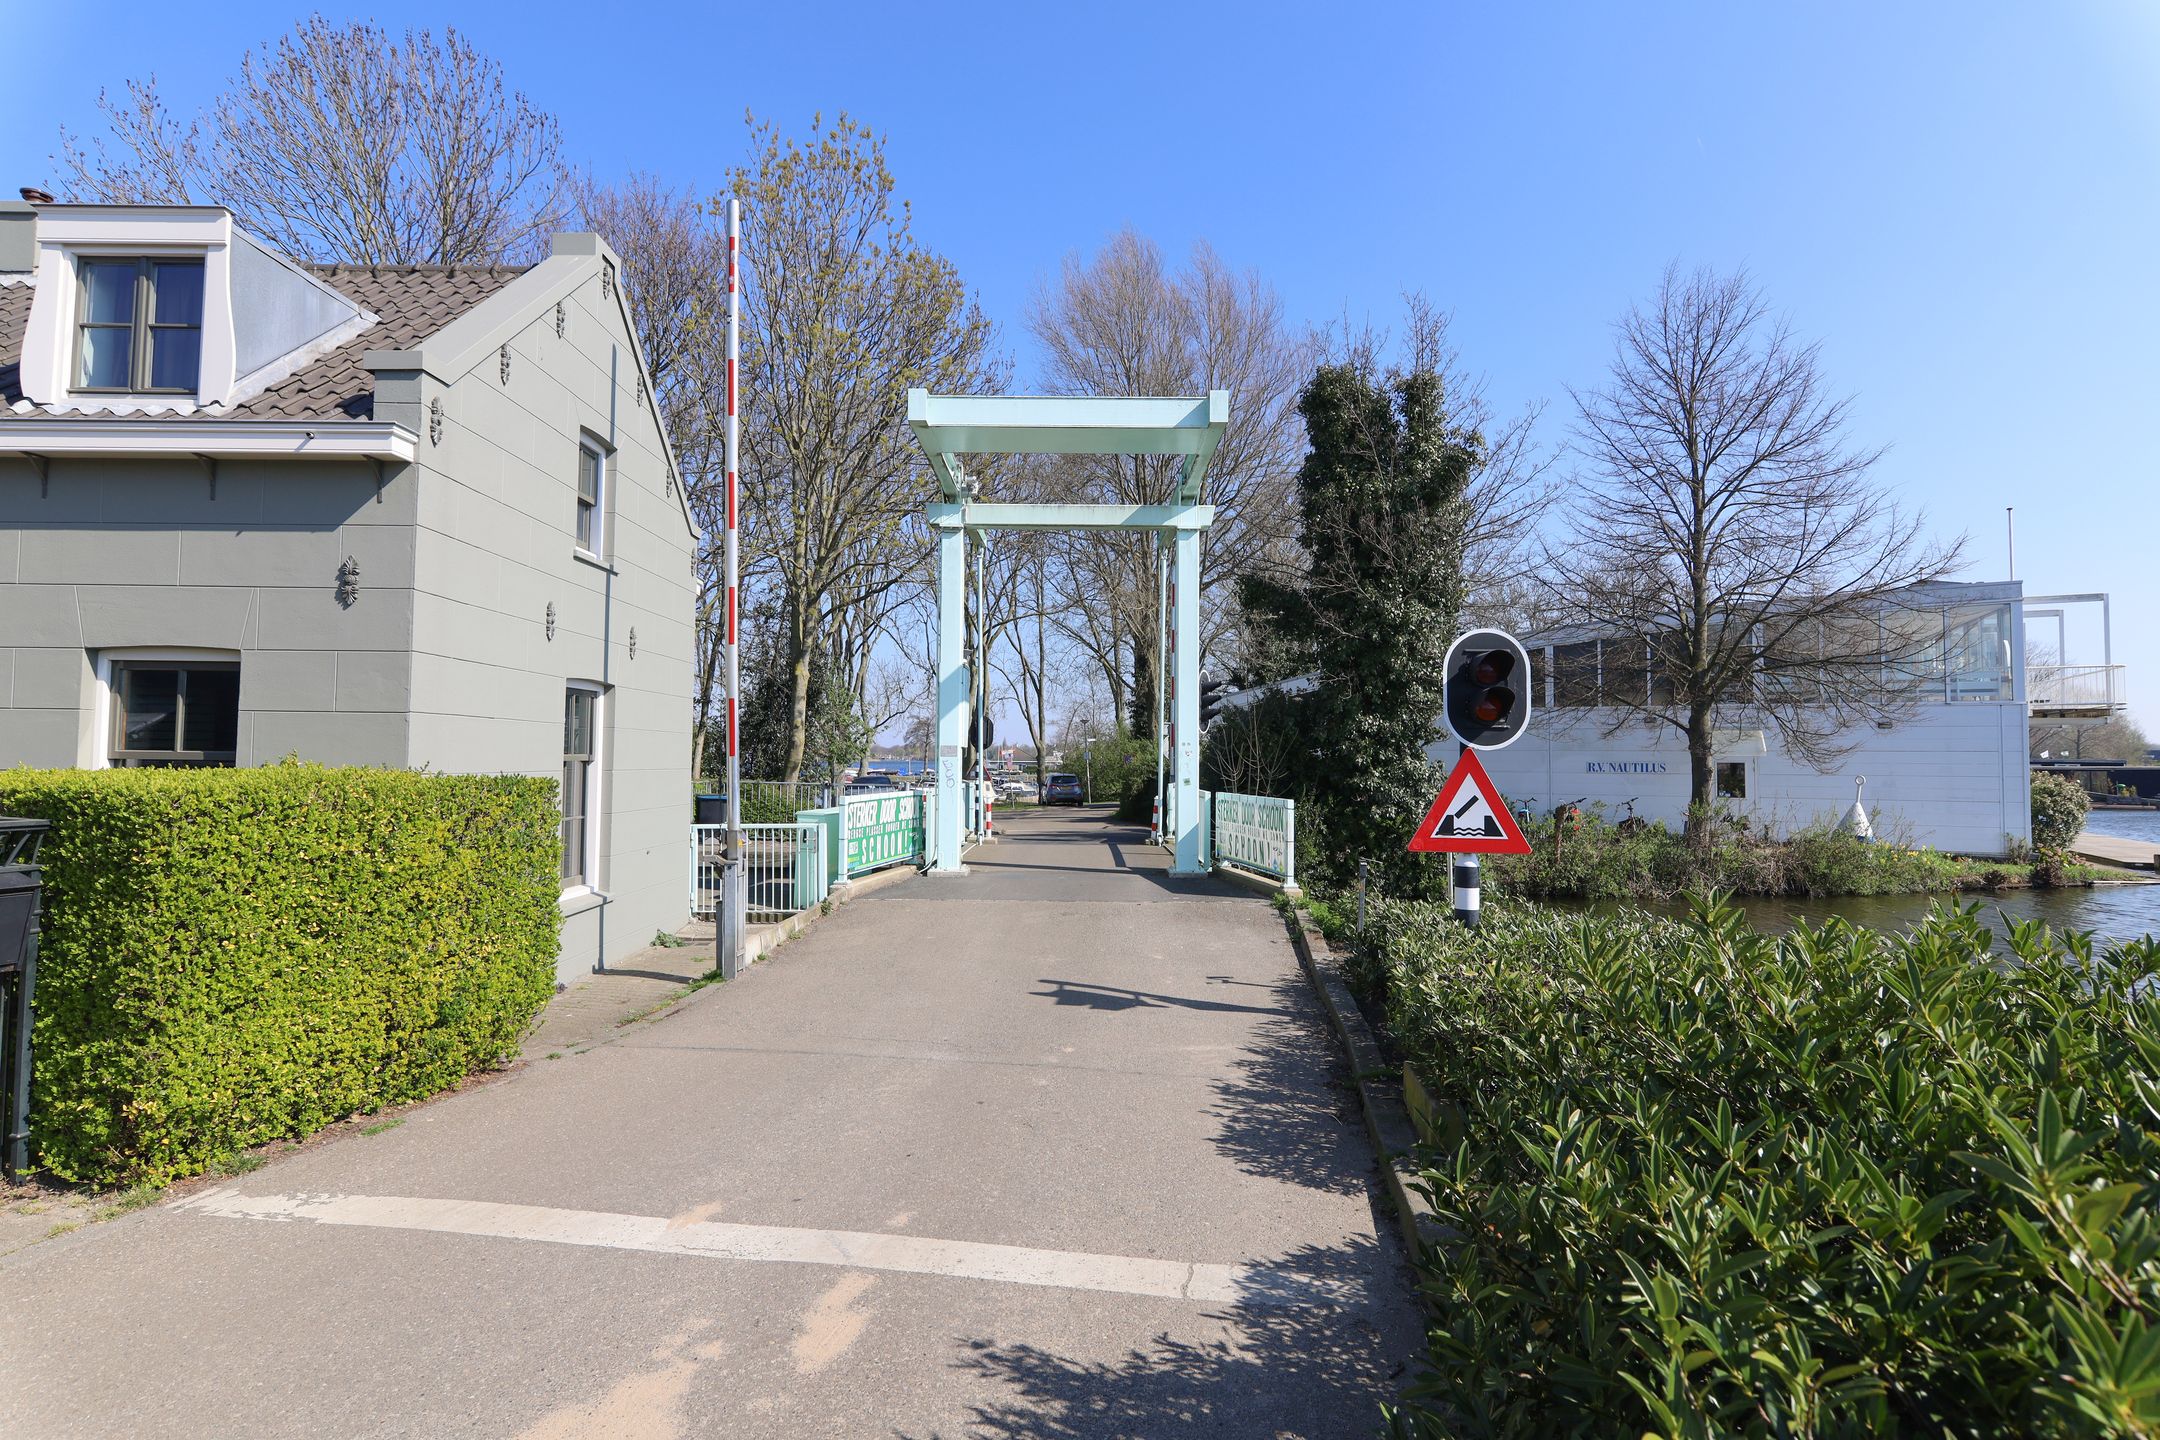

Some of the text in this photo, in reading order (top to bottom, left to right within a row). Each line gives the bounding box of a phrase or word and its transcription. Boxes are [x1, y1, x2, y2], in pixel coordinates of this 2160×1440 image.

[1587, 762, 1667, 773] R.V. NAUTILUS
[848, 800, 878, 829] STERKER
[879, 798, 897, 824] DOOR
[1258, 804, 1284, 833] SCHOON
